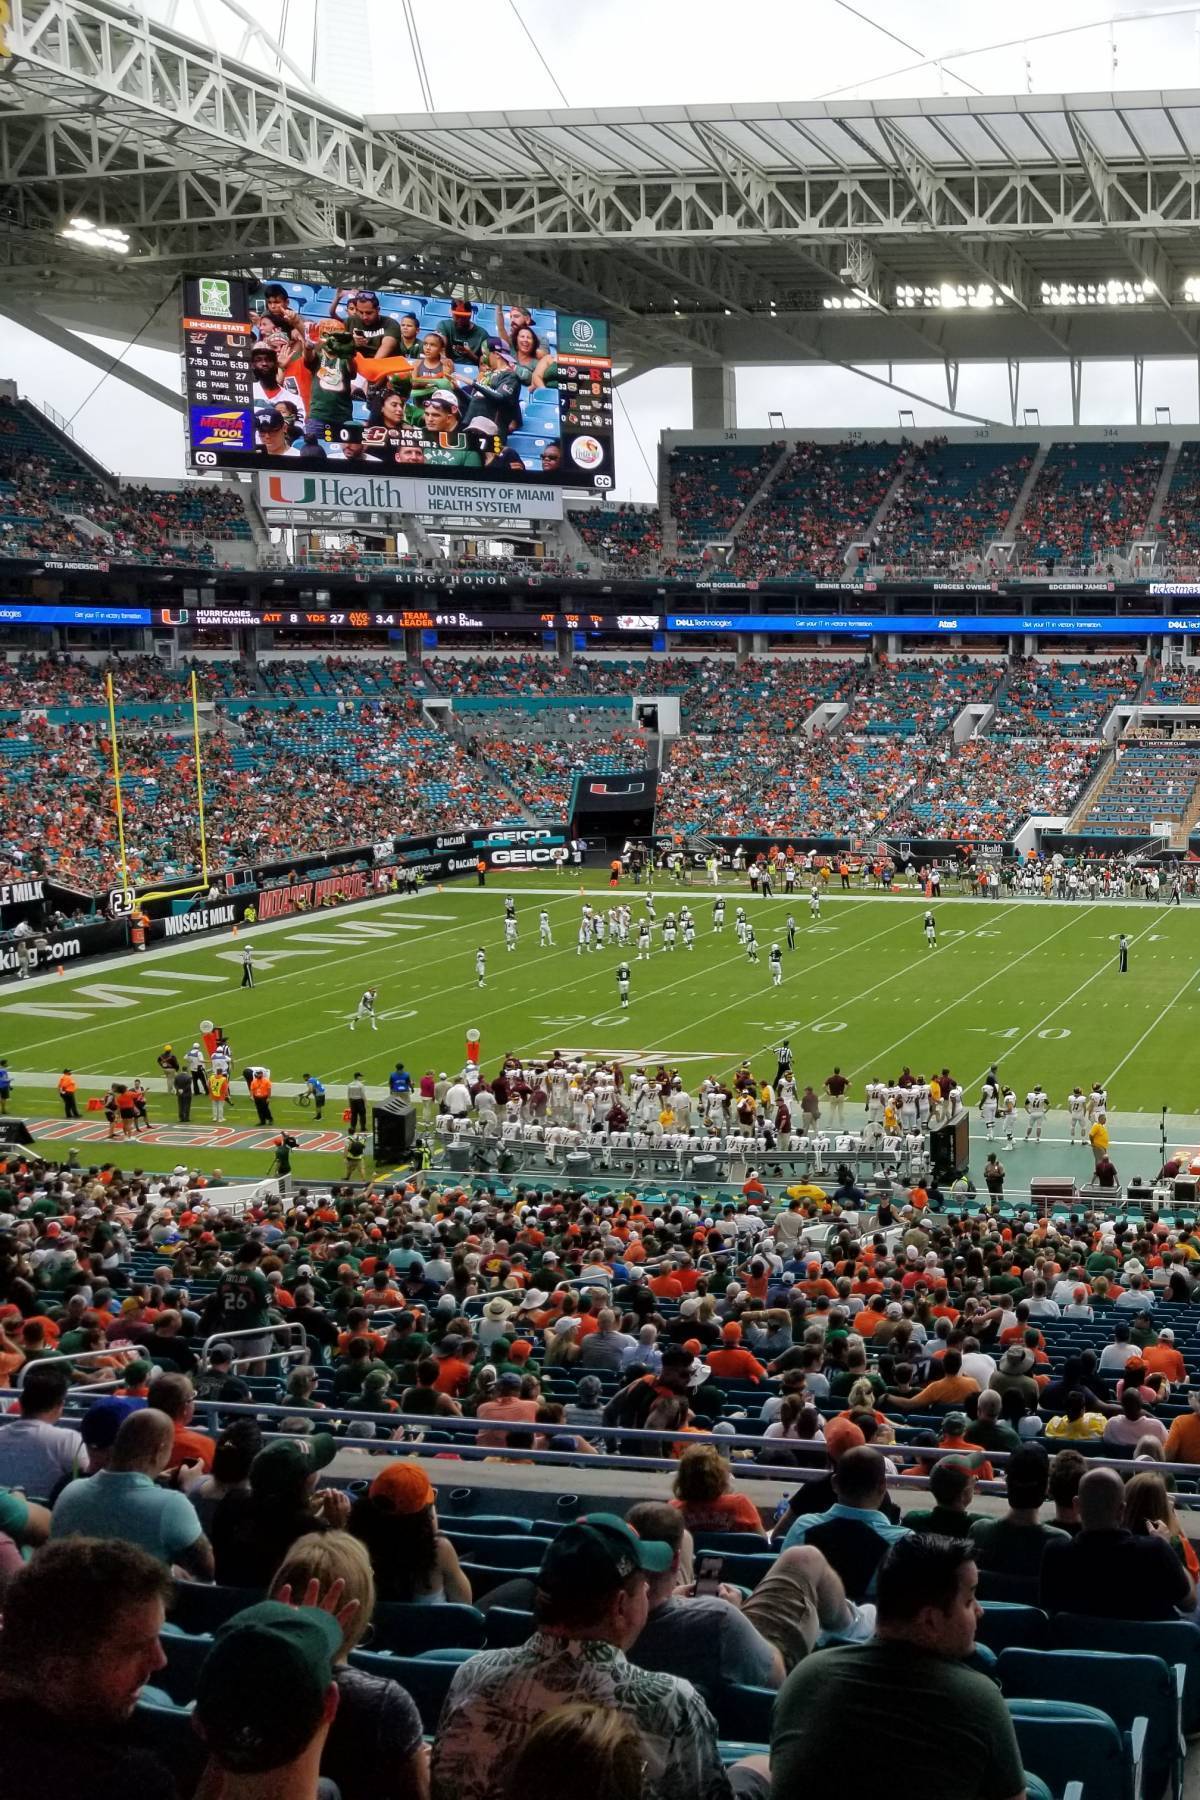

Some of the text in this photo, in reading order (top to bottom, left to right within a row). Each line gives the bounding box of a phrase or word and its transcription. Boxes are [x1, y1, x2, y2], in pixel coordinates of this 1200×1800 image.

[196, 369, 247, 381] 19 RUSH 27
[212, 381, 230, 389] PASS
[213, 428, 243, 438] TOOL
[401, 430, 423, 440] 14:43
[479, 439, 486, 450] 7
[197, 453, 215, 463] CC
[596, 477, 609, 486] CC
[428, 484, 555, 502] UNIVERSITY OF MIAMI
[428, 498, 522, 514] HEALTH SYSTEM
[64, 562, 99, 571] ANDERSON
[396, 574, 507, 585] RING HONOR
[933, 583, 964, 591] BURGESS
[1084, 583, 1108, 591] JAMES
[263, 614, 344, 623] ATT 8 YDS 27
[375, 615, 394, 624] 3.4
[400, 619, 483, 627] LEADER Dallas
[403, 612, 457, 625] TEAM #13
[492, 848, 569, 863] GEICO
[12, 880, 44, 902] MILK
[165, 905, 235, 937] MUSCLE MILK
[762, 1020, 848, 1033] 30
[990, 1027, 1072, 1039] 40
[224, 1292, 248, 1310] 26
